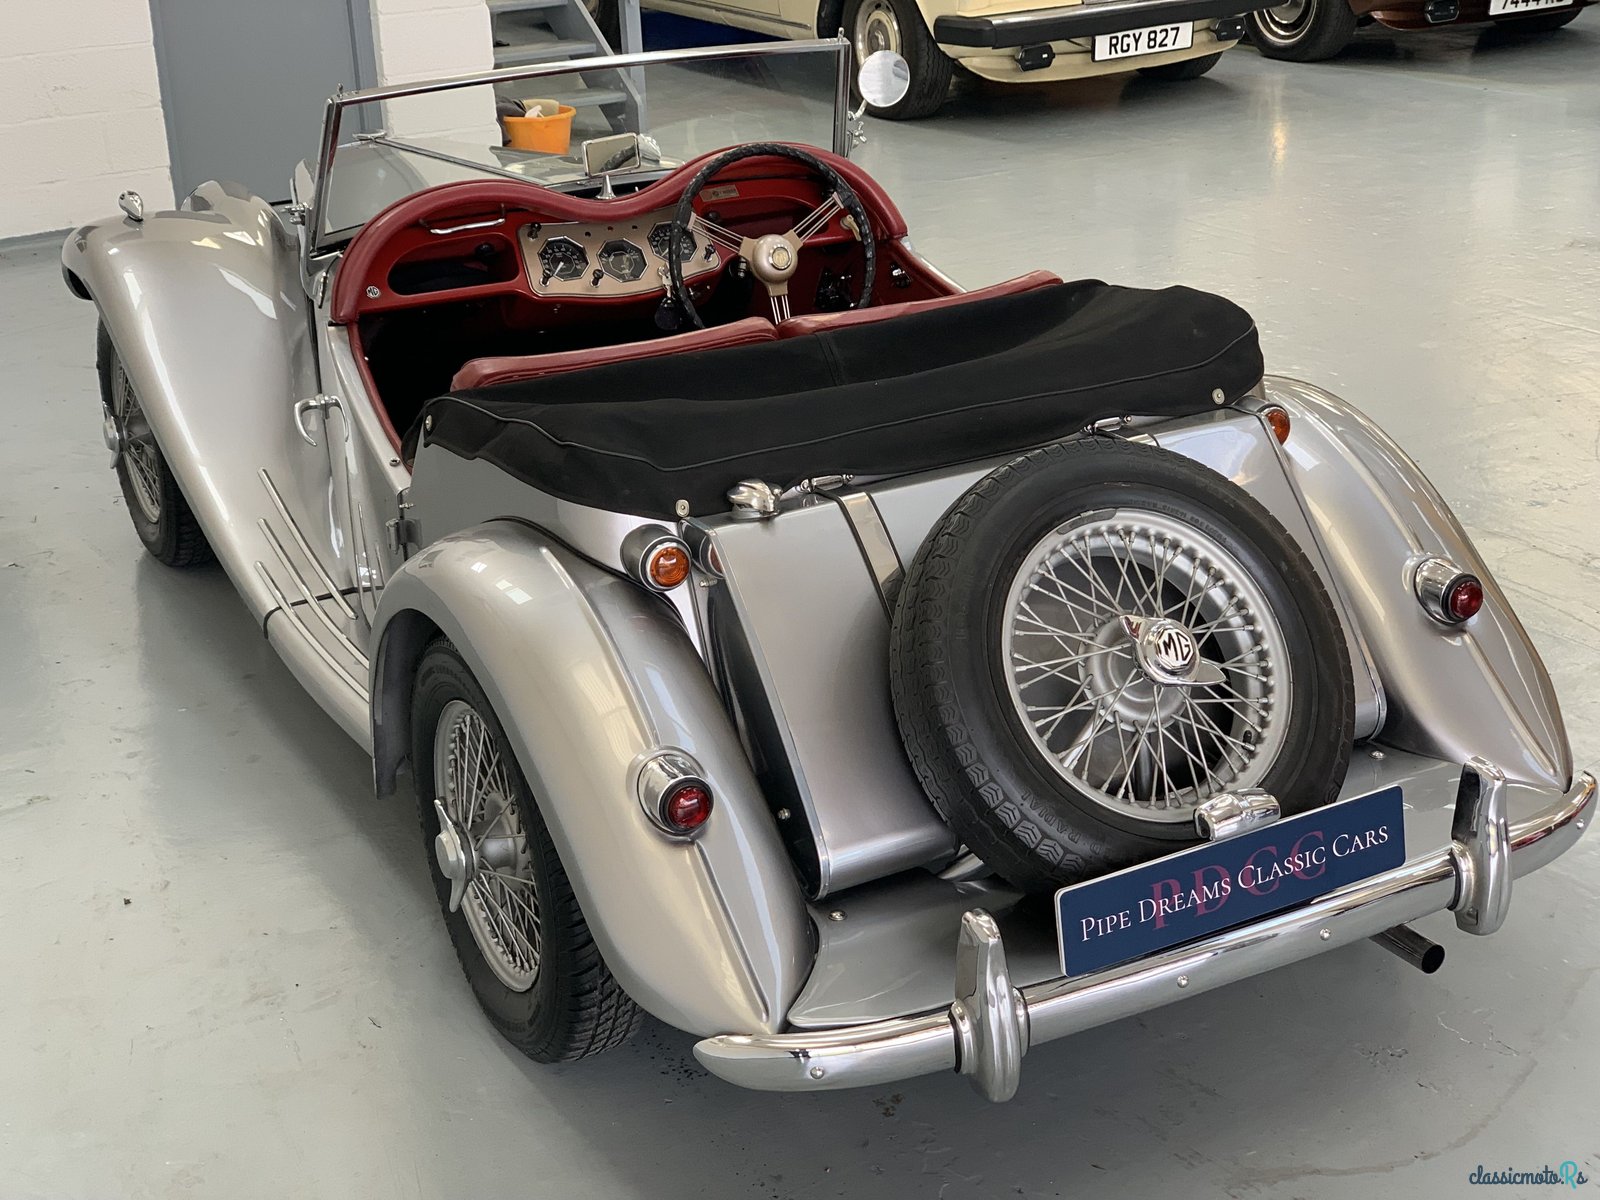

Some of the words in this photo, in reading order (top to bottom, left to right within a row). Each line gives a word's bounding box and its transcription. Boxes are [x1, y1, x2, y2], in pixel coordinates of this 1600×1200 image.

[1108, 32, 1142, 55] RGY
[1147, 26, 1180, 49] 827
[1162, 631, 1192, 662] MG
[1021, 788, 1081, 844] RADIAL
[1080, 910, 1132, 942] PIPE
[1137, 878, 1232, 924] DREAMS
[1238, 846, 1326, 889] CLASSIC
[1332, 825, 1389, 858] CARS
